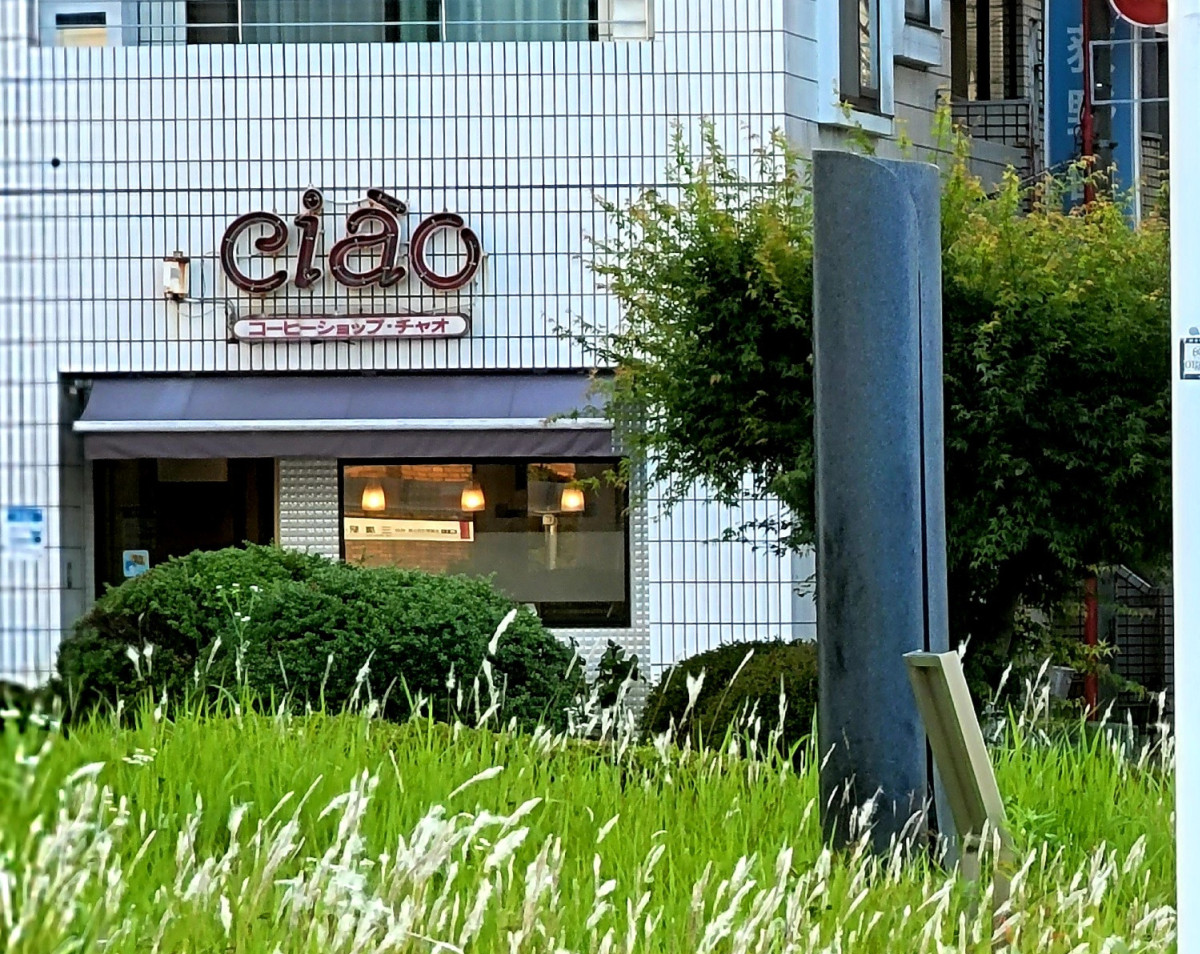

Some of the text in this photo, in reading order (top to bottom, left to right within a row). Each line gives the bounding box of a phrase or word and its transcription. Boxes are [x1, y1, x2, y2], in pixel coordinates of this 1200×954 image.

[249, 319, 449, 336] コーヒーショップ・チャオ
